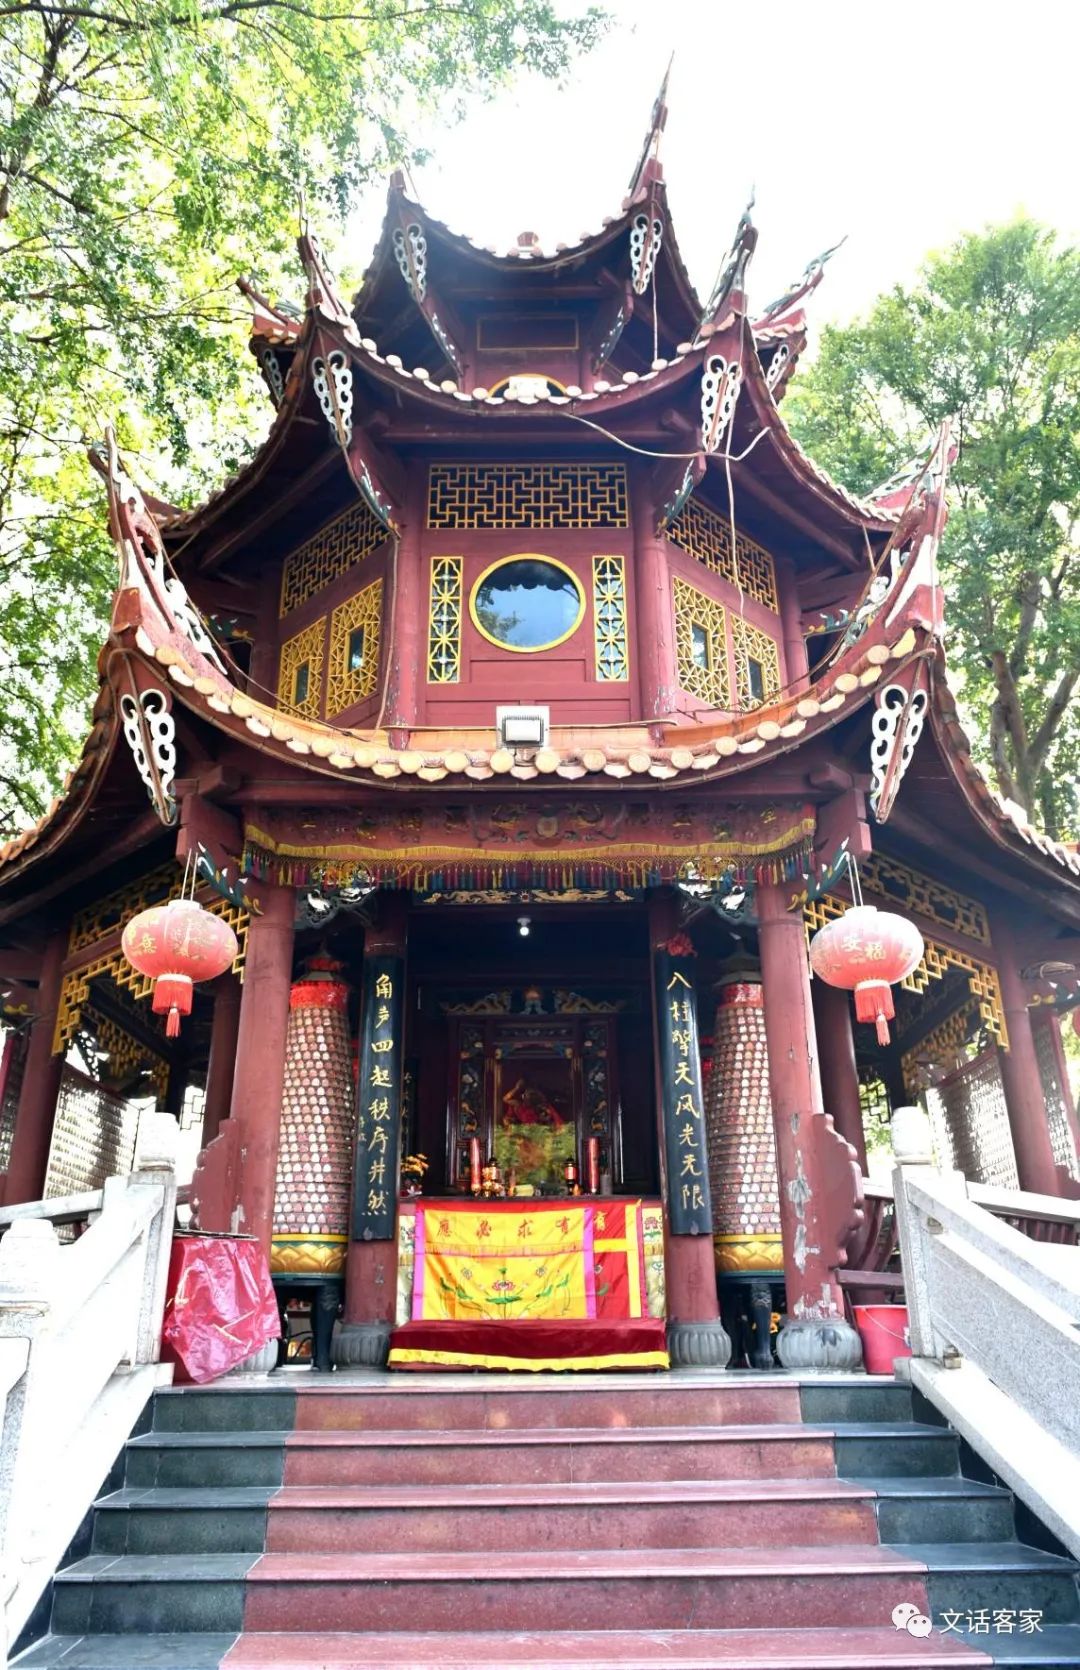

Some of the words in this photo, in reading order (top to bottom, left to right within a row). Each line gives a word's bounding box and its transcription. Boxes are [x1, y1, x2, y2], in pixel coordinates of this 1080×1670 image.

[362, 973, 393, 1216] 角声四起秩序井然
[667, 971, 705, 1210] 八柱擎天风光无限
